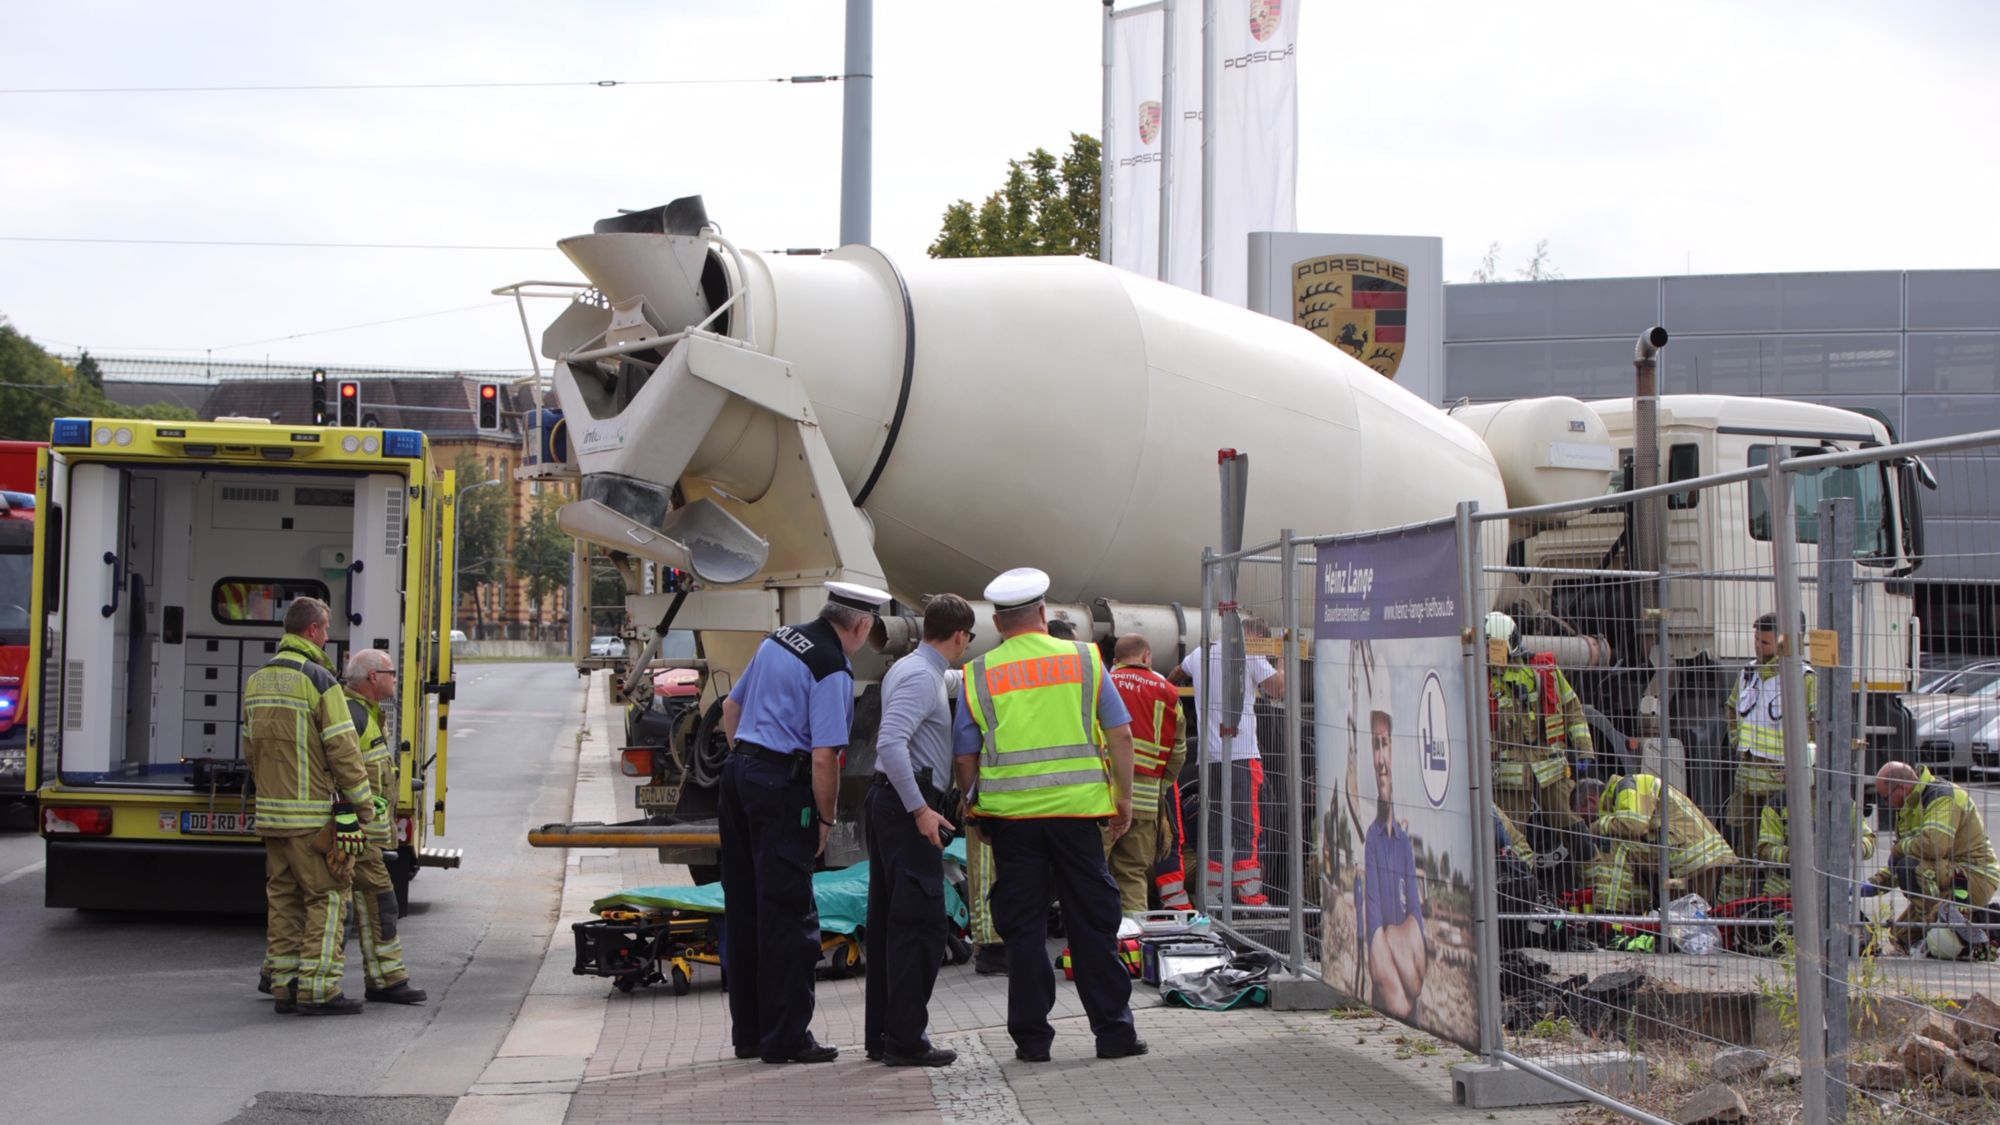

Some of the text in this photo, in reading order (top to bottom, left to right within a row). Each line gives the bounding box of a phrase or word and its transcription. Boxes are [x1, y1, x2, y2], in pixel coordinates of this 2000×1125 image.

[1224, 43, 1294, 72] PORSCHE
[1297, 258, 1405, 282] PORSCHE
[1324, 561, 1374, 600] Heinz Lange
[990, 655, 1080, 694] POLIZEI
[1119, 680, 1134, 691] FW
[191, 814, 208, 829] DD
[217, 815, 236, 830] RD
